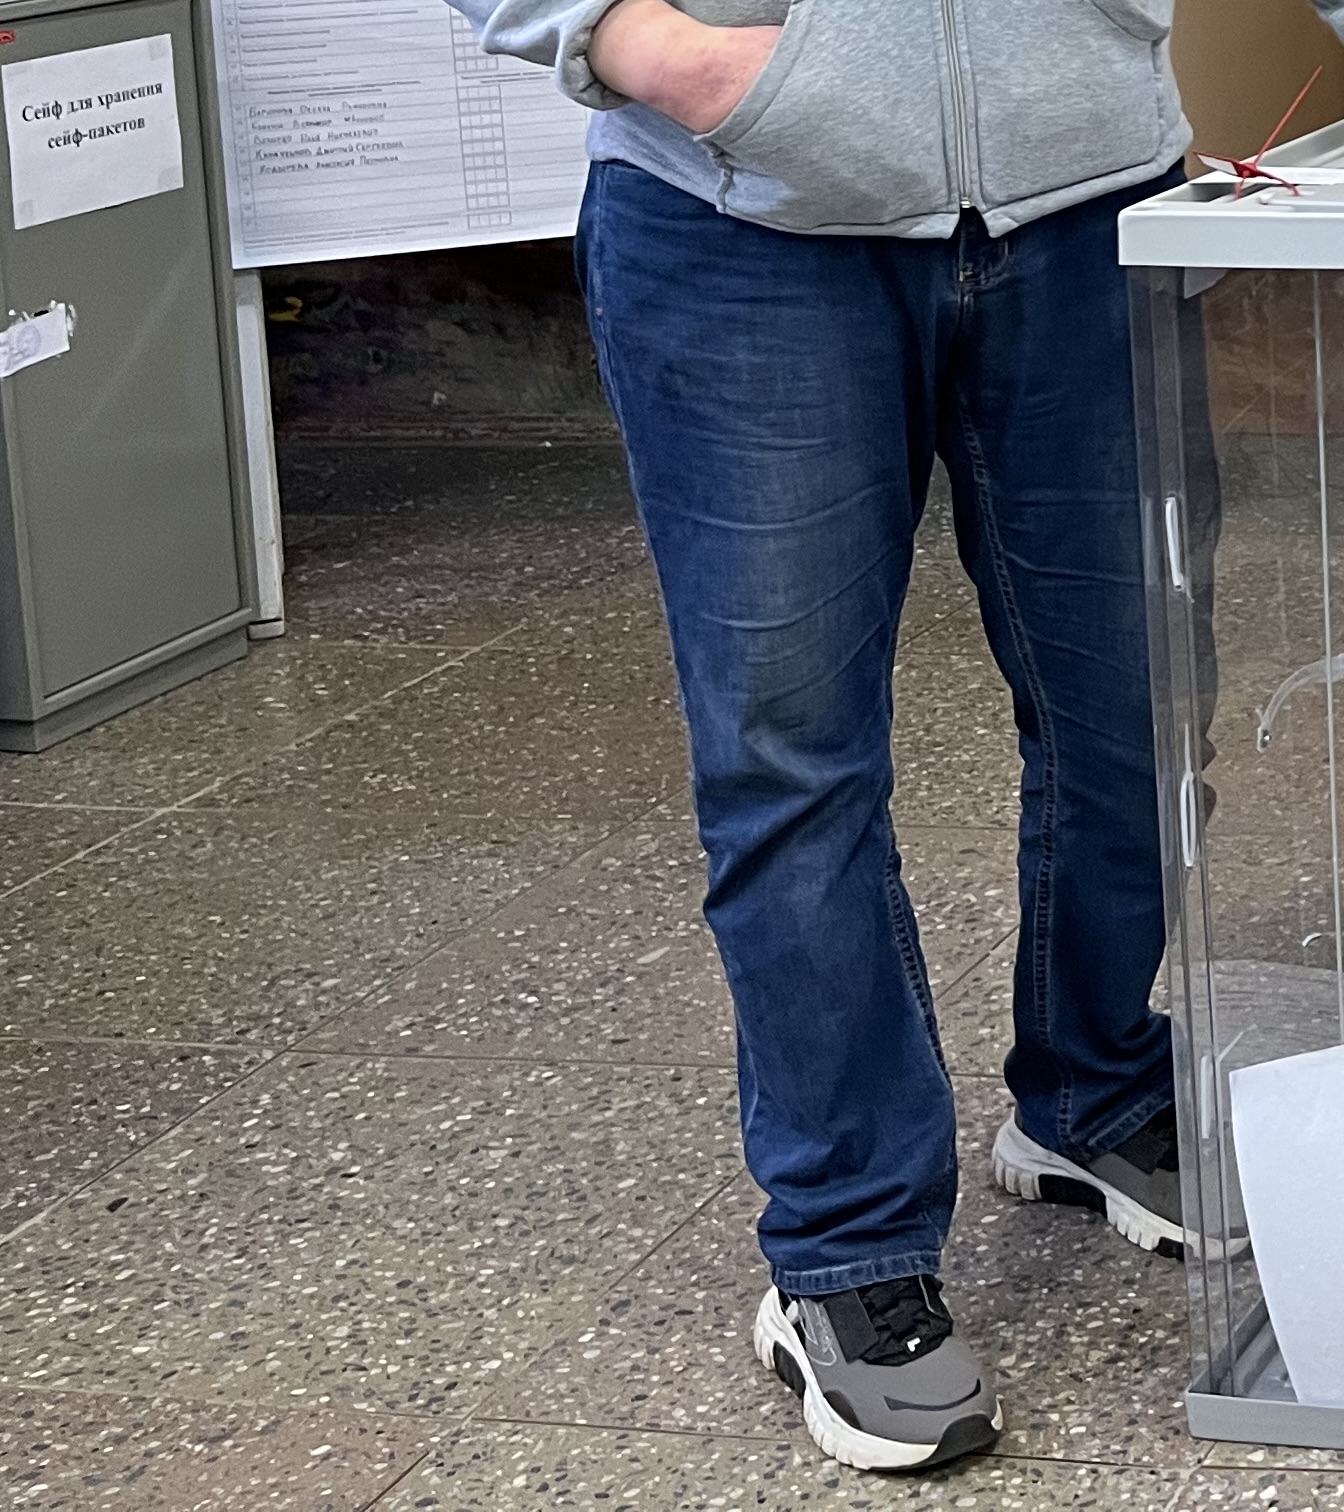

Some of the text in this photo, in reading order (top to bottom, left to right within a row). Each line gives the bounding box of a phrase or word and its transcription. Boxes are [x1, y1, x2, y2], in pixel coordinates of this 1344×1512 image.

[22, 83, 163, 122] Сейф для хранения
[48, 117, 145, 148] сейф-пакетов
